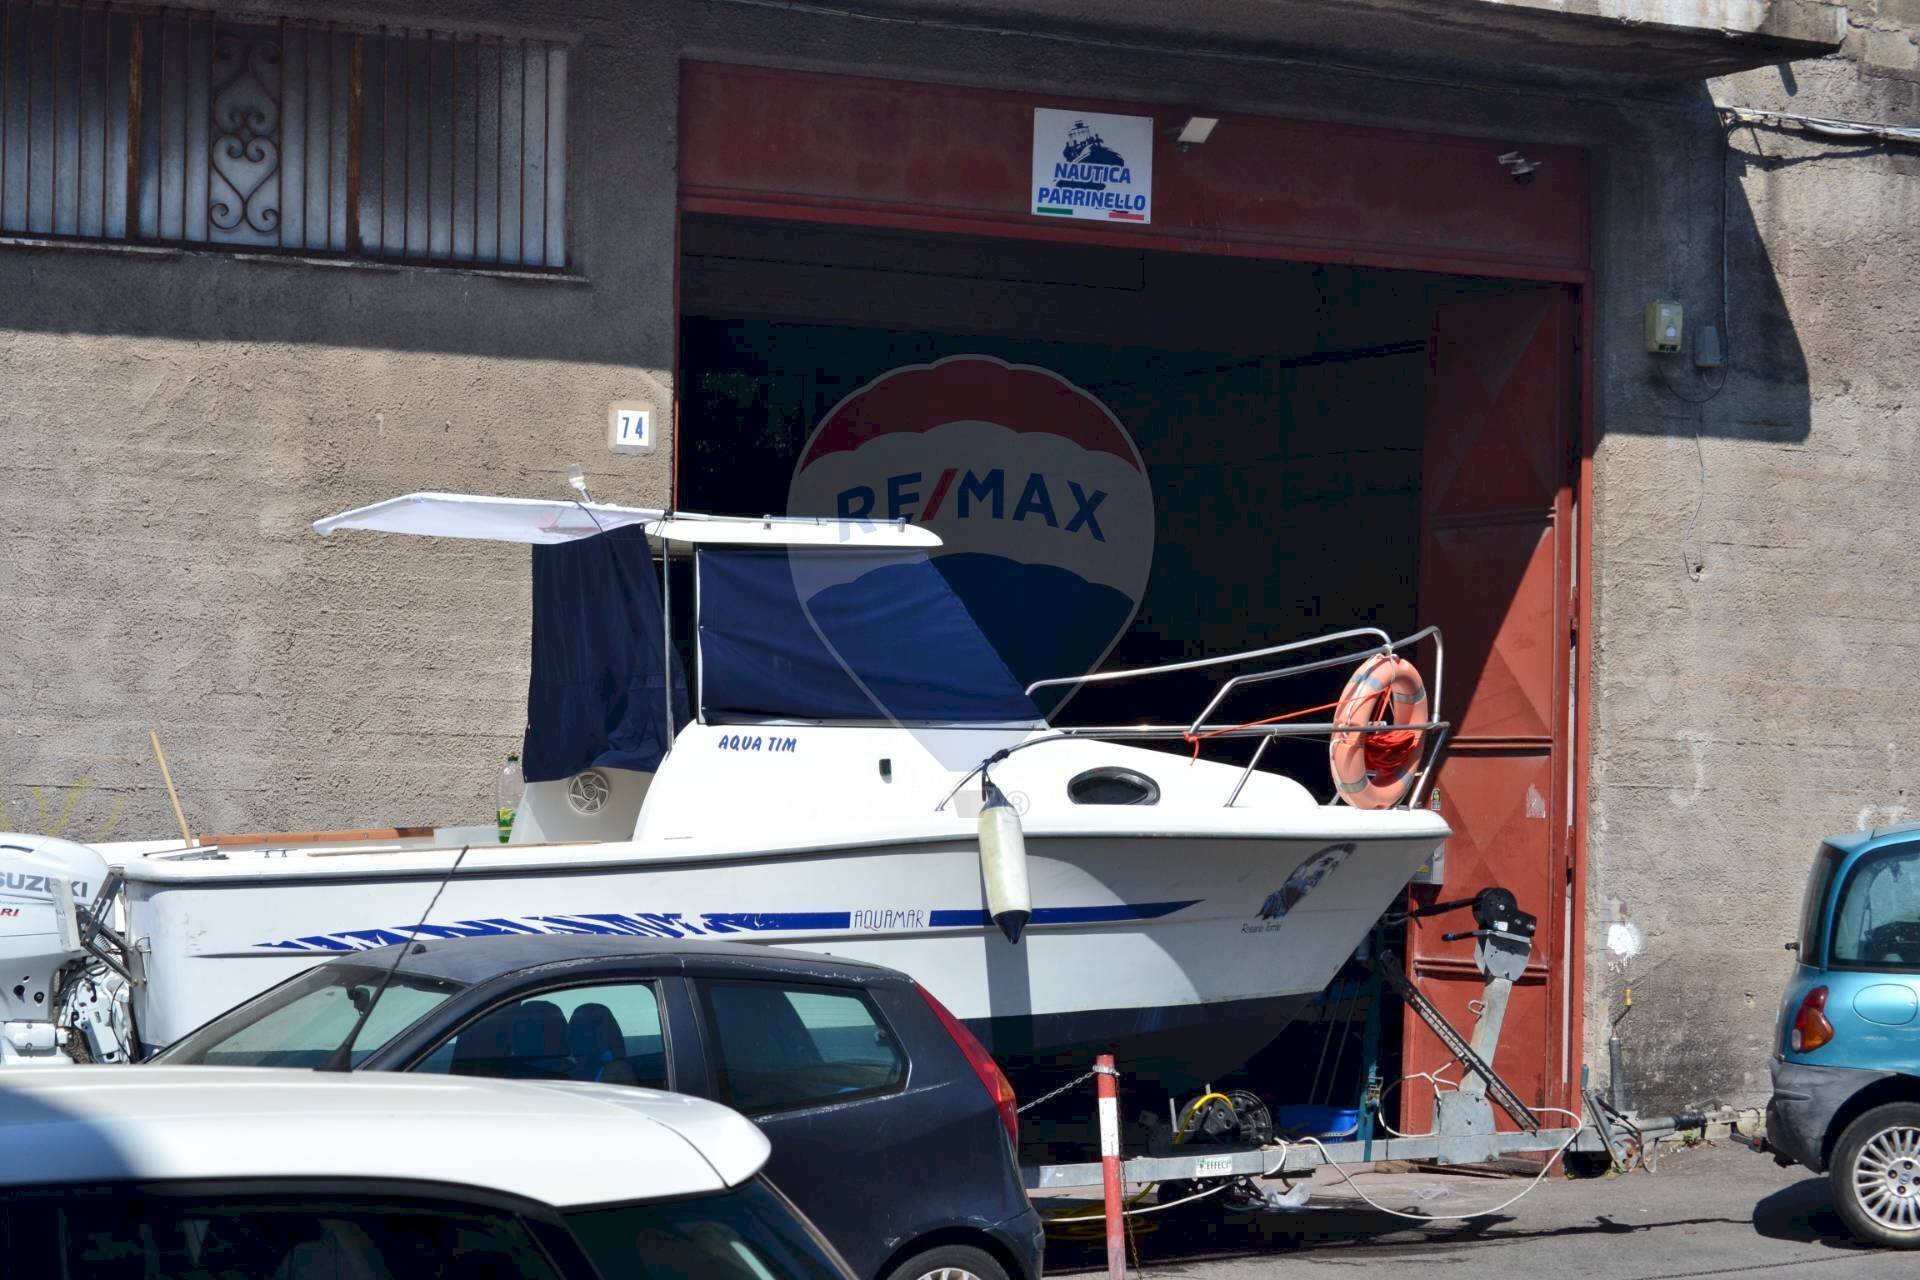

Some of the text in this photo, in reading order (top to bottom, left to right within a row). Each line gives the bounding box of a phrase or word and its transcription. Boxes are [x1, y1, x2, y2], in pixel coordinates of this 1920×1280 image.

[1054, 163, 1131, 184] NAUTICA
[1038, 187, 1146, 211] PARRINELLO
[622, 416, 643, 439] 74
[718, 735, 797, 752] AQUA TIM
[854, 909, 924, 931] AQUAMAR
